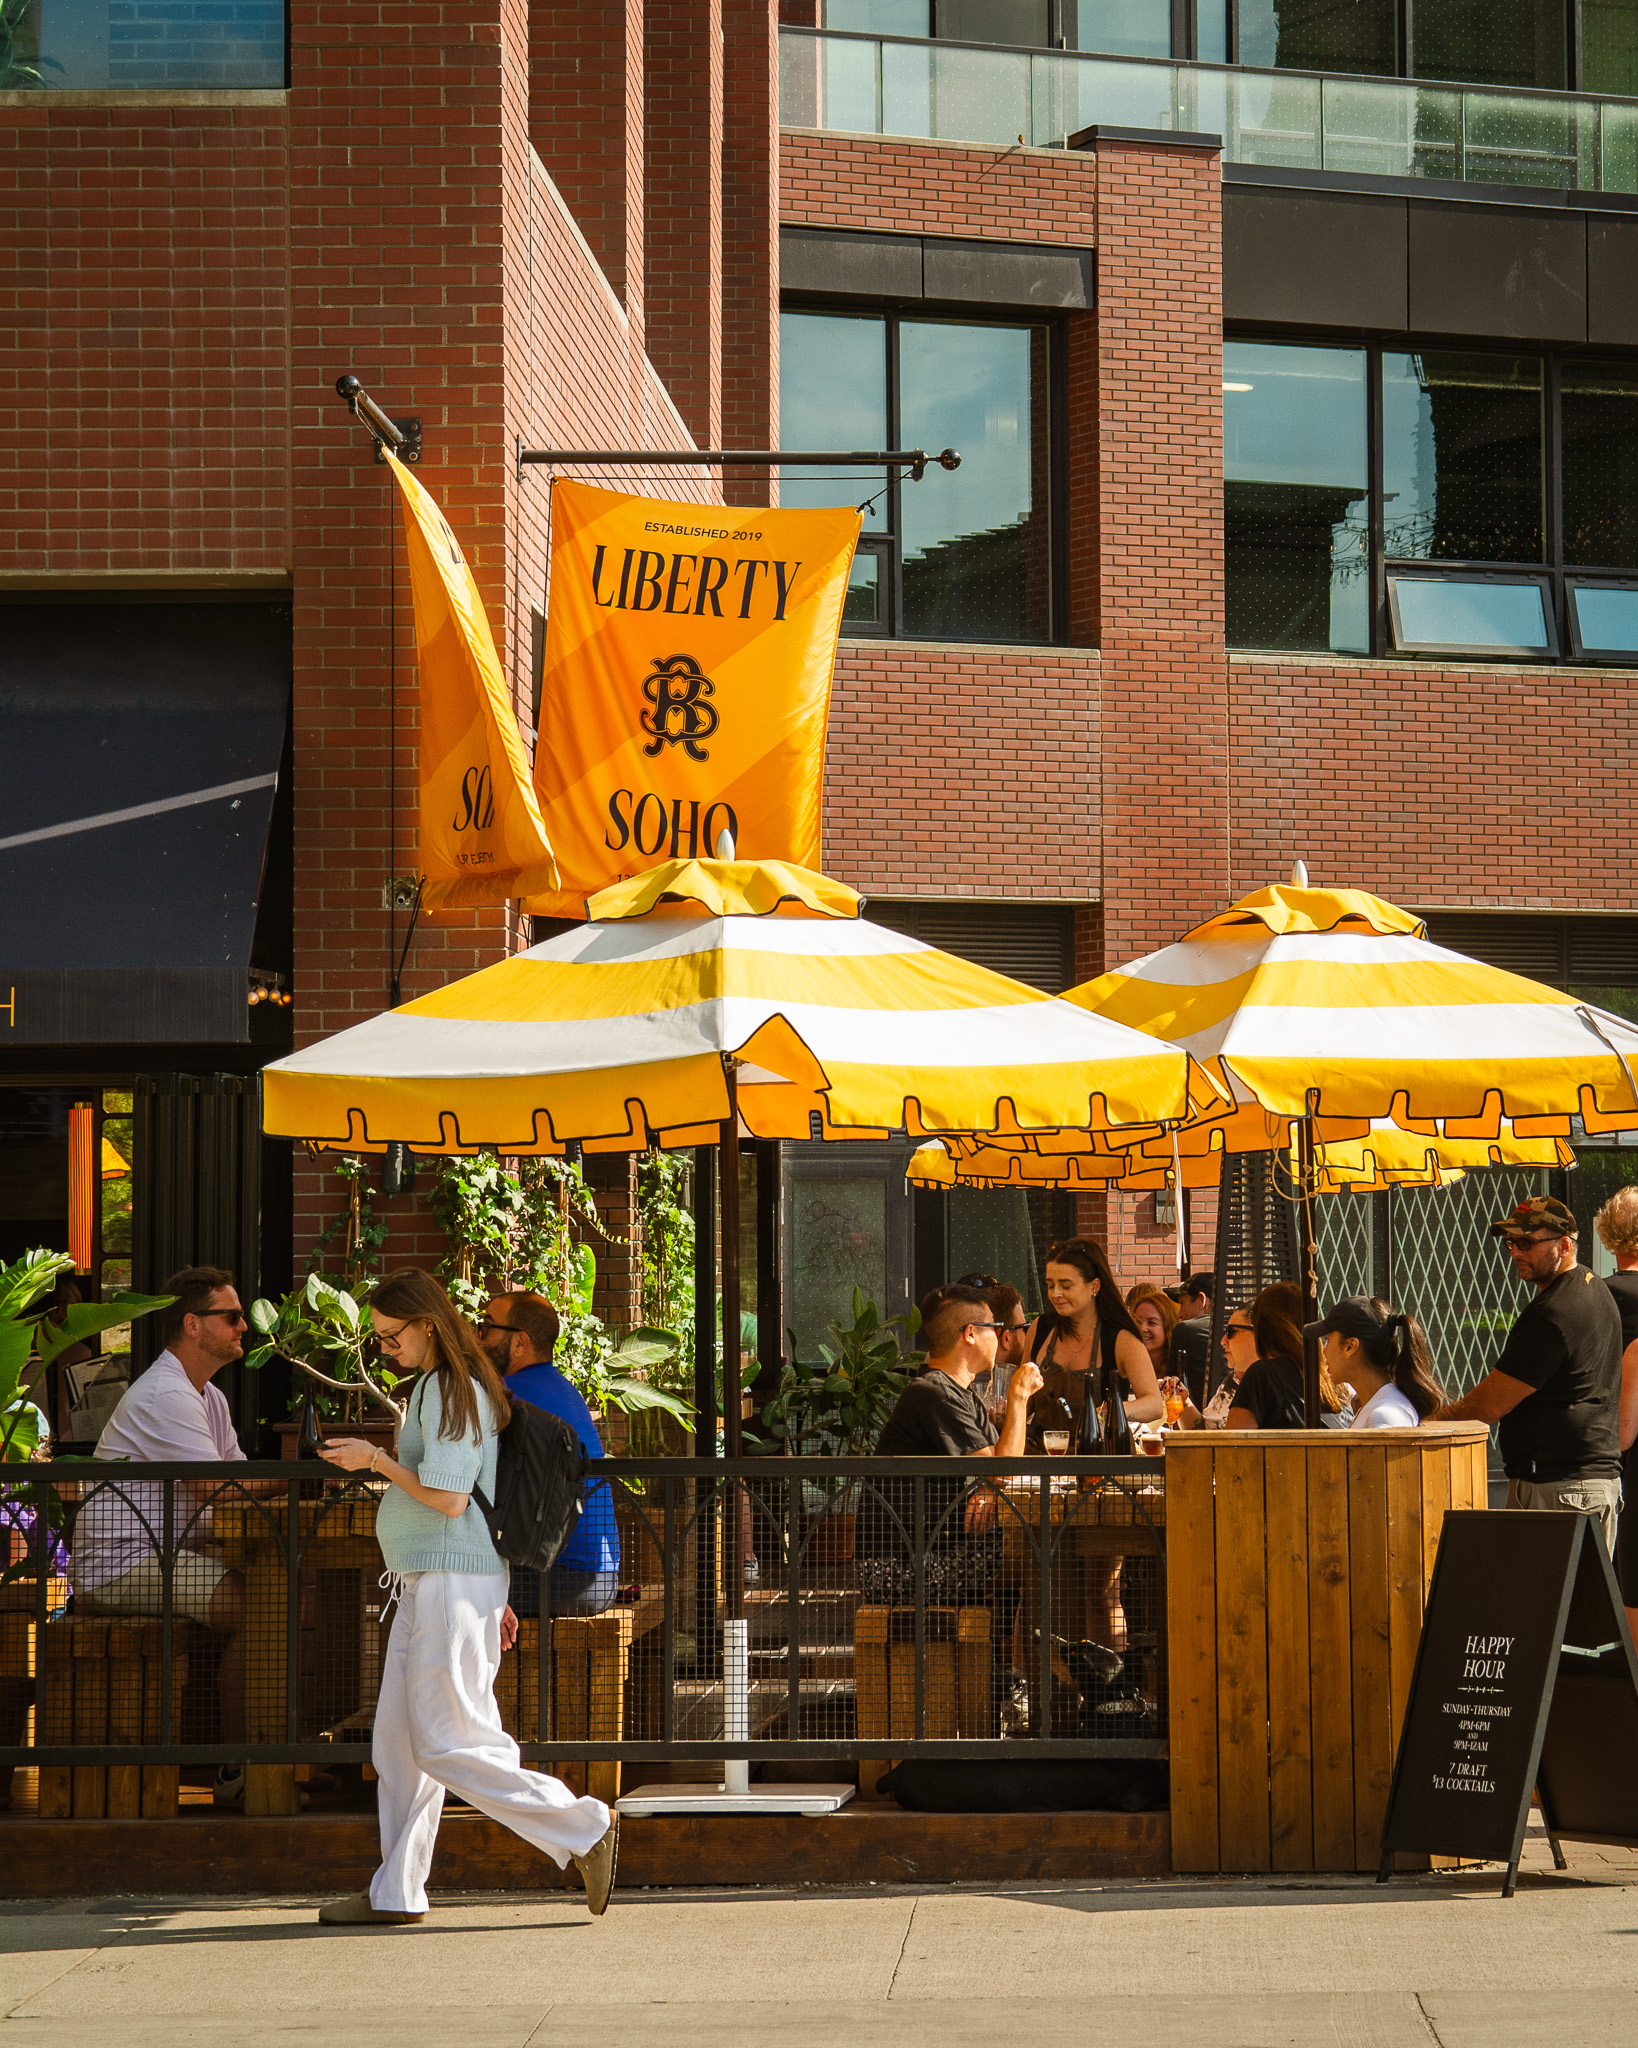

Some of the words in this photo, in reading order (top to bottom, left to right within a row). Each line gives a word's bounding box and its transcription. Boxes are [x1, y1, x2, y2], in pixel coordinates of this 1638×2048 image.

[644, 521, 729, 540] ESTABLISHED
[732, 530, 763, 542] 2019
[592, 544, 803, 621] LIBERTY
[604, 788, 739, 860] SOHO
[1464, 1635, 1515, 1655] HAPPY
[1463, 1659, 1506, 1679] HOUR
[1441, 1702, 1513, 1717] SUNDAY-THURSDAY
[1458, 1719, 1491, 1731] 4PM-6PM
[1467, 1732, 1479, 1740] AND
[1453, 1740, 1489, 1752] 9PM-12AM
[1449, 1762, 1456, 1774] 7
[1457, 1763, 1488, 1777] DRAFT
[1432, 1774, 1444, 1789] $13
[1446, 1777, 1496, 1793] COCKTAILS
